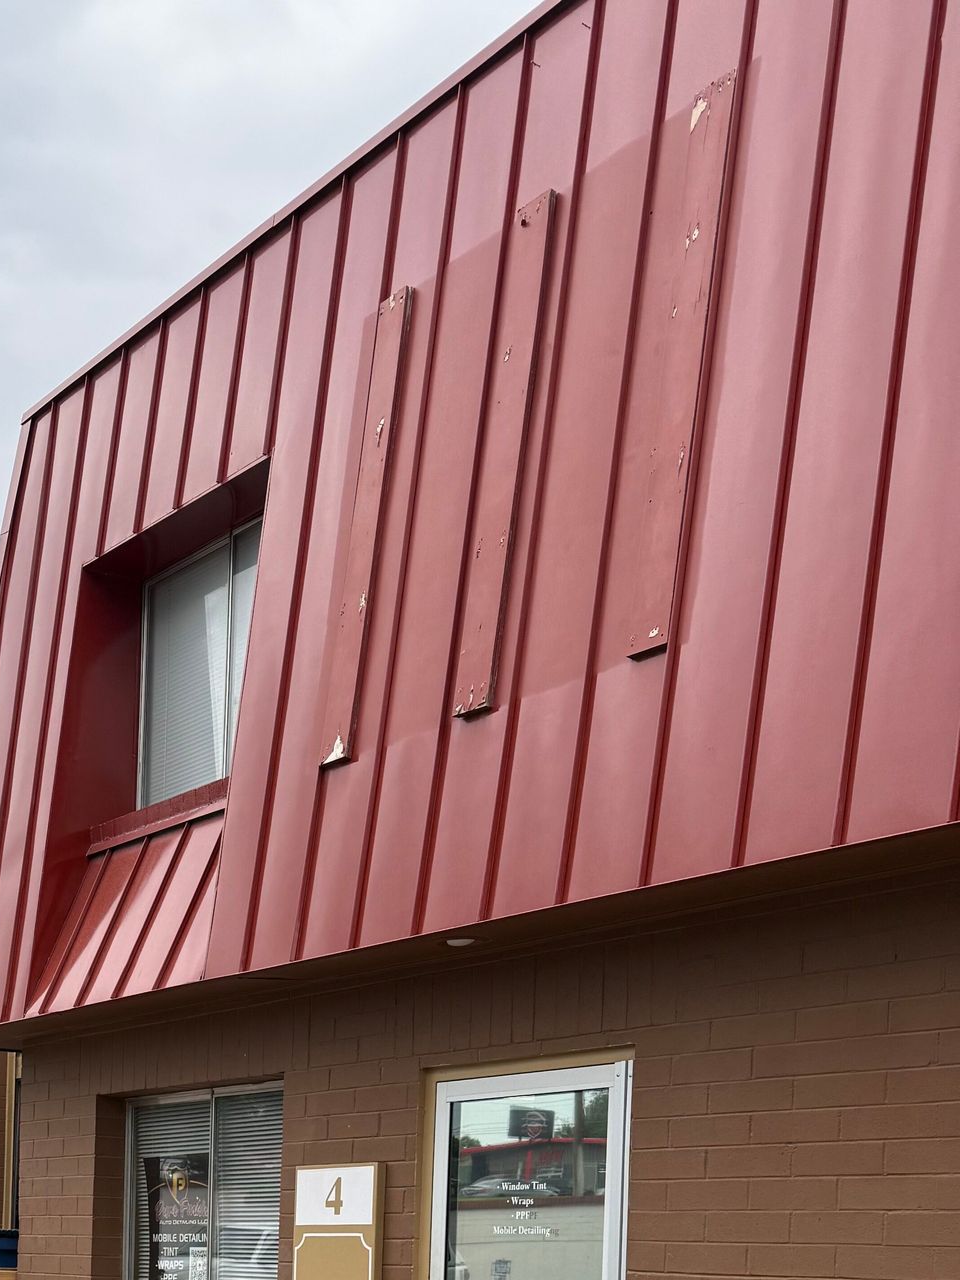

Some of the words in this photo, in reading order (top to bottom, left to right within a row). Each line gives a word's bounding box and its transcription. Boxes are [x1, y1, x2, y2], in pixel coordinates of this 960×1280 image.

[501, 1182, 530, 1191] Window
[531, 1181, 547, 1190] Tint
[325, 1176, 344, 1216] 4
[511, 1196, 534, 1208] Wraps
[515, 1211, 530, 1220] PPF
[493, 1226, 517, 1235] Mobile
[518, 1225, 551, 1238] Detailing
[152, 1233, 177, 1243] MOBILE
